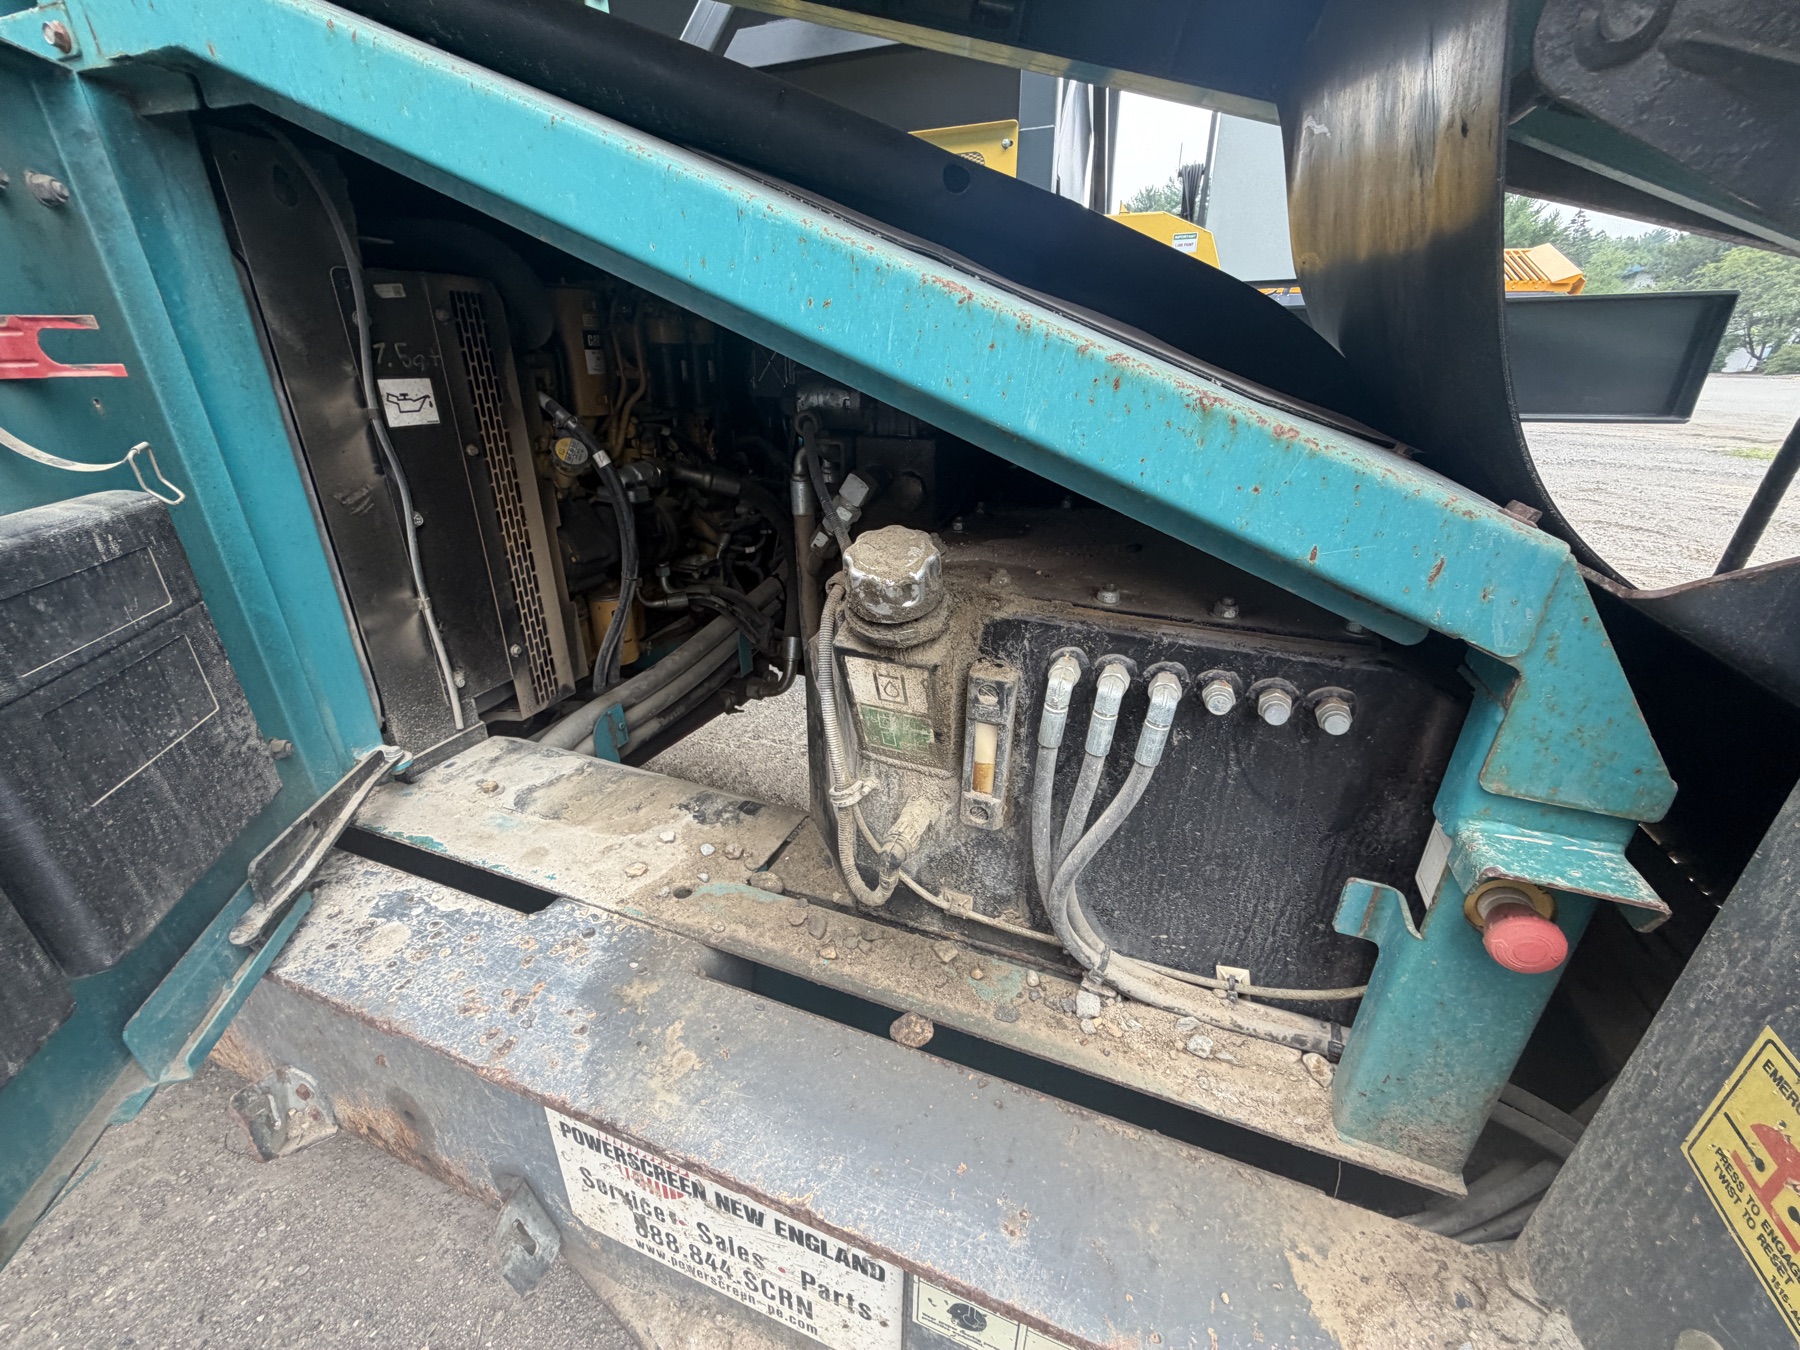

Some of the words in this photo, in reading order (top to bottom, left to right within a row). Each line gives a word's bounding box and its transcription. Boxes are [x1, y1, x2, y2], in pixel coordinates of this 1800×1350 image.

[1762, 1058, 1800, 1116] EMER
[559, 1120, 706, 1200] POWERSCREEN
[715, 1191, 764, 1228] NEW
[774, 1218, 886, 1283] ENGLAND
[1714, 1161, 1742, 1204] TWIST
[1742, 1207, 1755, 1230] TO
[1756, 1233, 1794, 1284] RESET
[1715, 1147, 1745, 1193] PRESS
[1746, 1194, 1760, 1216] TO
[1761, 1219, 1800, 1284] ENGAG
[696, 1222, 765, 1270] Sales
[801, 1270, 872, 1321] Parts
